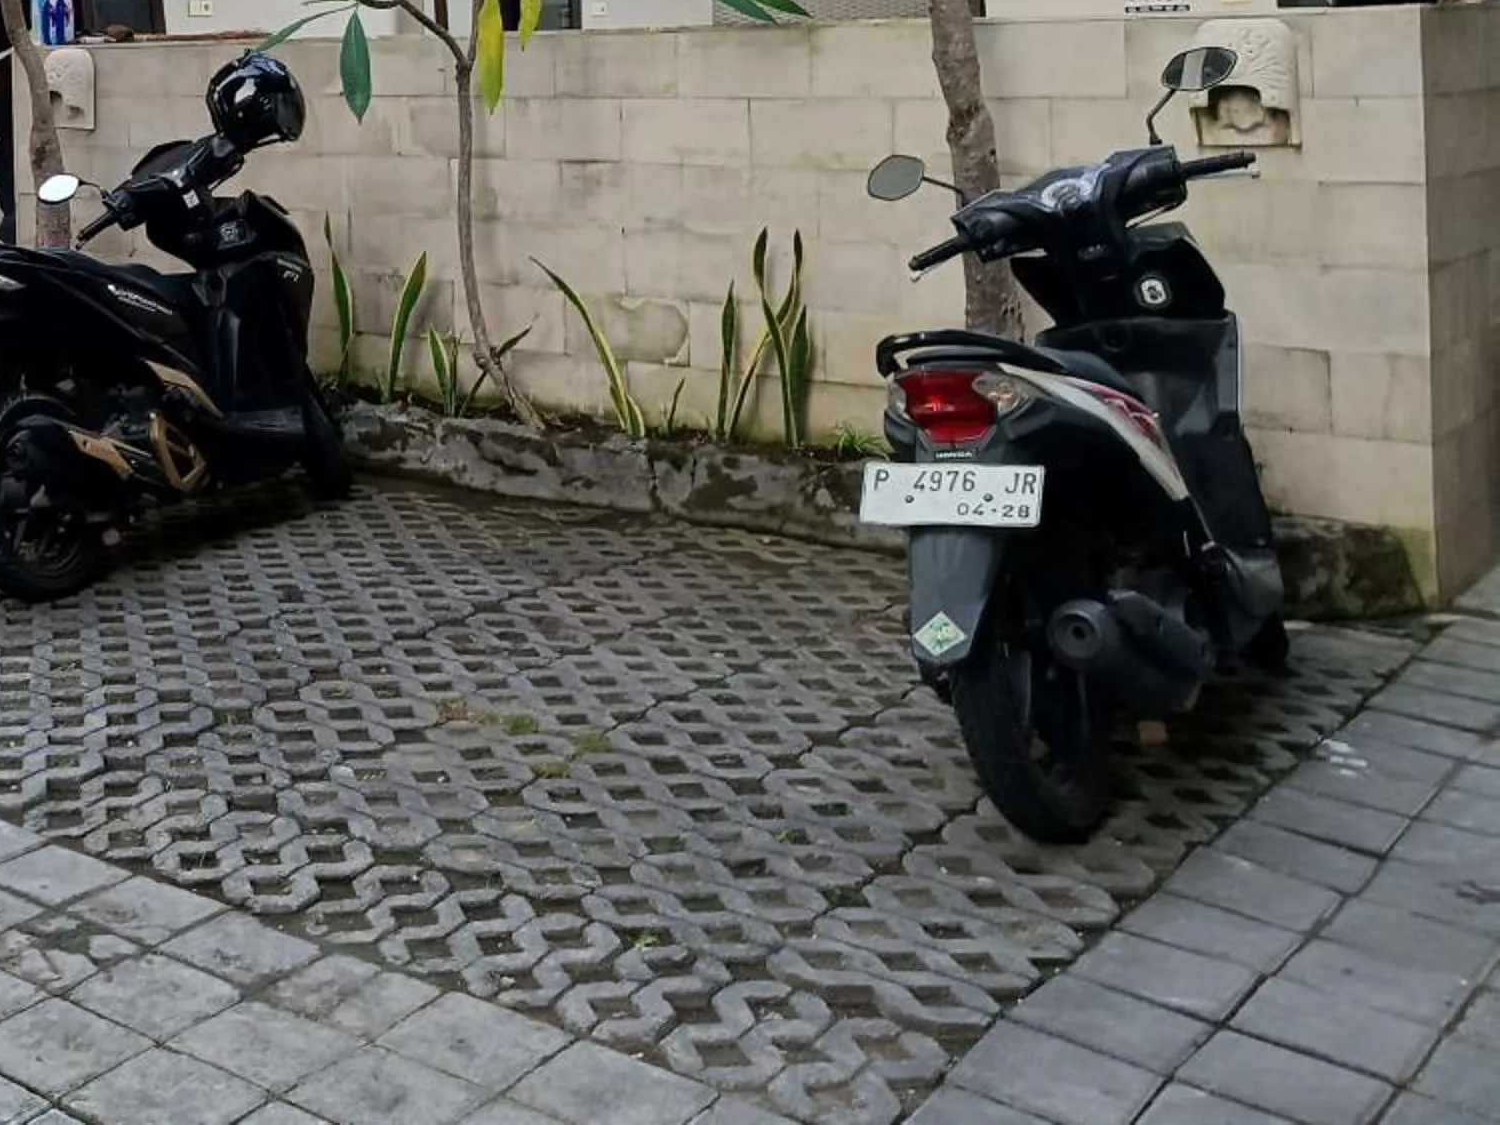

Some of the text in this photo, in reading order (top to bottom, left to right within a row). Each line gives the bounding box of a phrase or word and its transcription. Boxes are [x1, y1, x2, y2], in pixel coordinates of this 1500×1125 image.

[873, 468, 1037, 495] P 4976 JR
